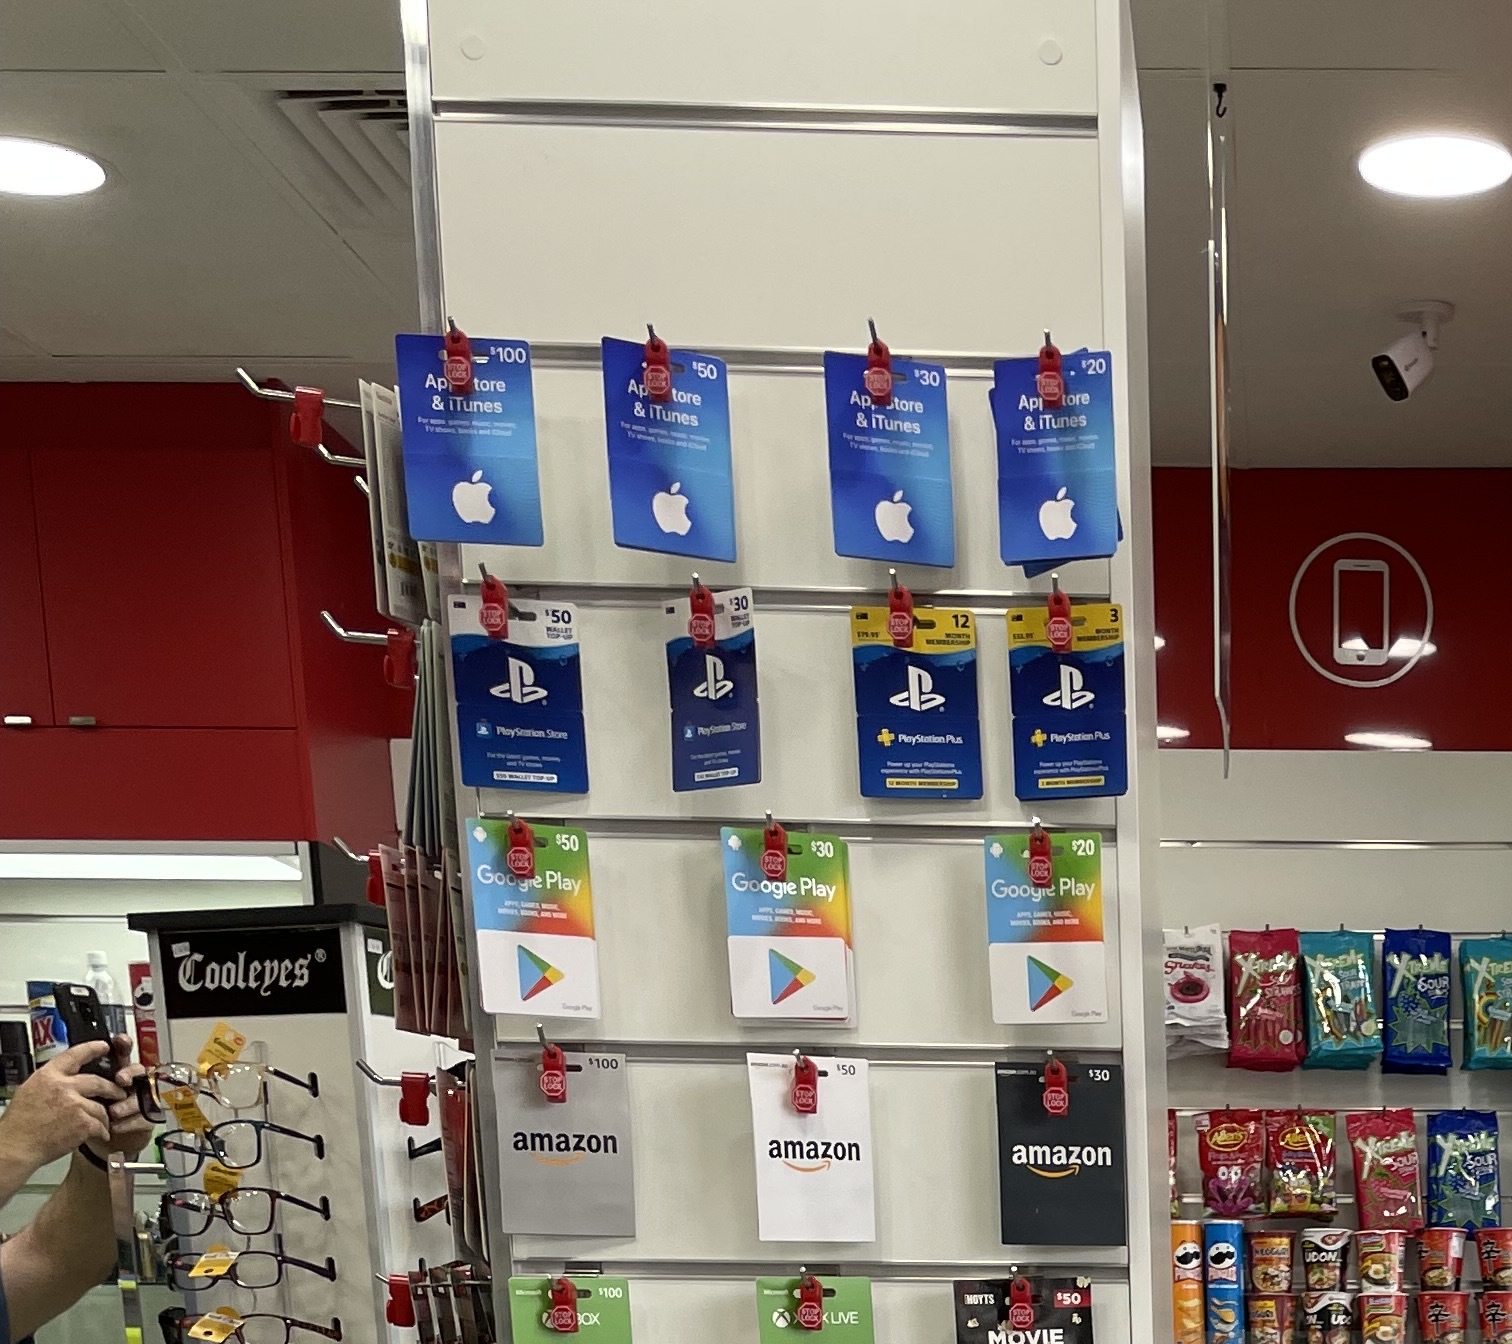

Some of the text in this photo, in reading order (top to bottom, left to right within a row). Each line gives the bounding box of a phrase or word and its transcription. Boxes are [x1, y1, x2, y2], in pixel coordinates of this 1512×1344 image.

[490, 346, 527, 364] $100
[692, 362, 718, 380] $50
[1082, 358, 1106, 376] $20
[473, 375, 507, 393] tore
[914, 368, 940, 387] $30
[431, 396, 502, 414] & iTunes
[672, 389, 702, 407] tore
[1062, 393, 1091, 406] tore
[633, 402, 699, 427] & iTunes
[1024, 414, 1087, 431] & iTunes
[856, 413, 921, 434] & iTunes
[729, 595, 749, 611] $30
[545, 608, 572, 625] $50
[952, 614, 970, 628] 12
[1110, 608, 1119, 622] 3
[496, 726, 545, 738] PlayStation
[898, 733, 963, 746] PlayStation Plus
[1050, 731, 1111, 744] PlayStation Plus
[556, 834, 580, 852] $50
[811, 840, 834, 858] $30
[1072, 839, 1095, 856] $20
[764, 855, 785, 863] STOP
[764, 862, 784, 871] LOCK
[546, 870, 582, 896] Play
[800, 878, 837, 902] Play
[1060, 877, 1095, 900] Play
[178, 951, 311, 996] Cooleyes
[588, 1057, 619, 1071] $100
[836, 1063, 856, 1077] $50
[1089, 1069, 1110, 1082] $30
[544, 1083, 563, 1092] LOCK
[1047, 1093, 1064, 1101] STOP
[1047, 1100, 1064, 1108] LOCK
[513, 1131, 618, 1155] amazon
[768, 1138, 861, 1162] amazon
[1012, 1144, 1112, 1167] amazon
[1305, 1252, 1337, 1262] UDON
[599, 1287, 623, 1299] $100
[964, 1293, 995, 1305] HOYTS
[1057, 1293, 1081, 1305] $50
[577, 1312, 600, 1326] BOX
[831, 1311, 859, 1324] LIVE
[1013, 1315, 1030, 1323] LOCK
